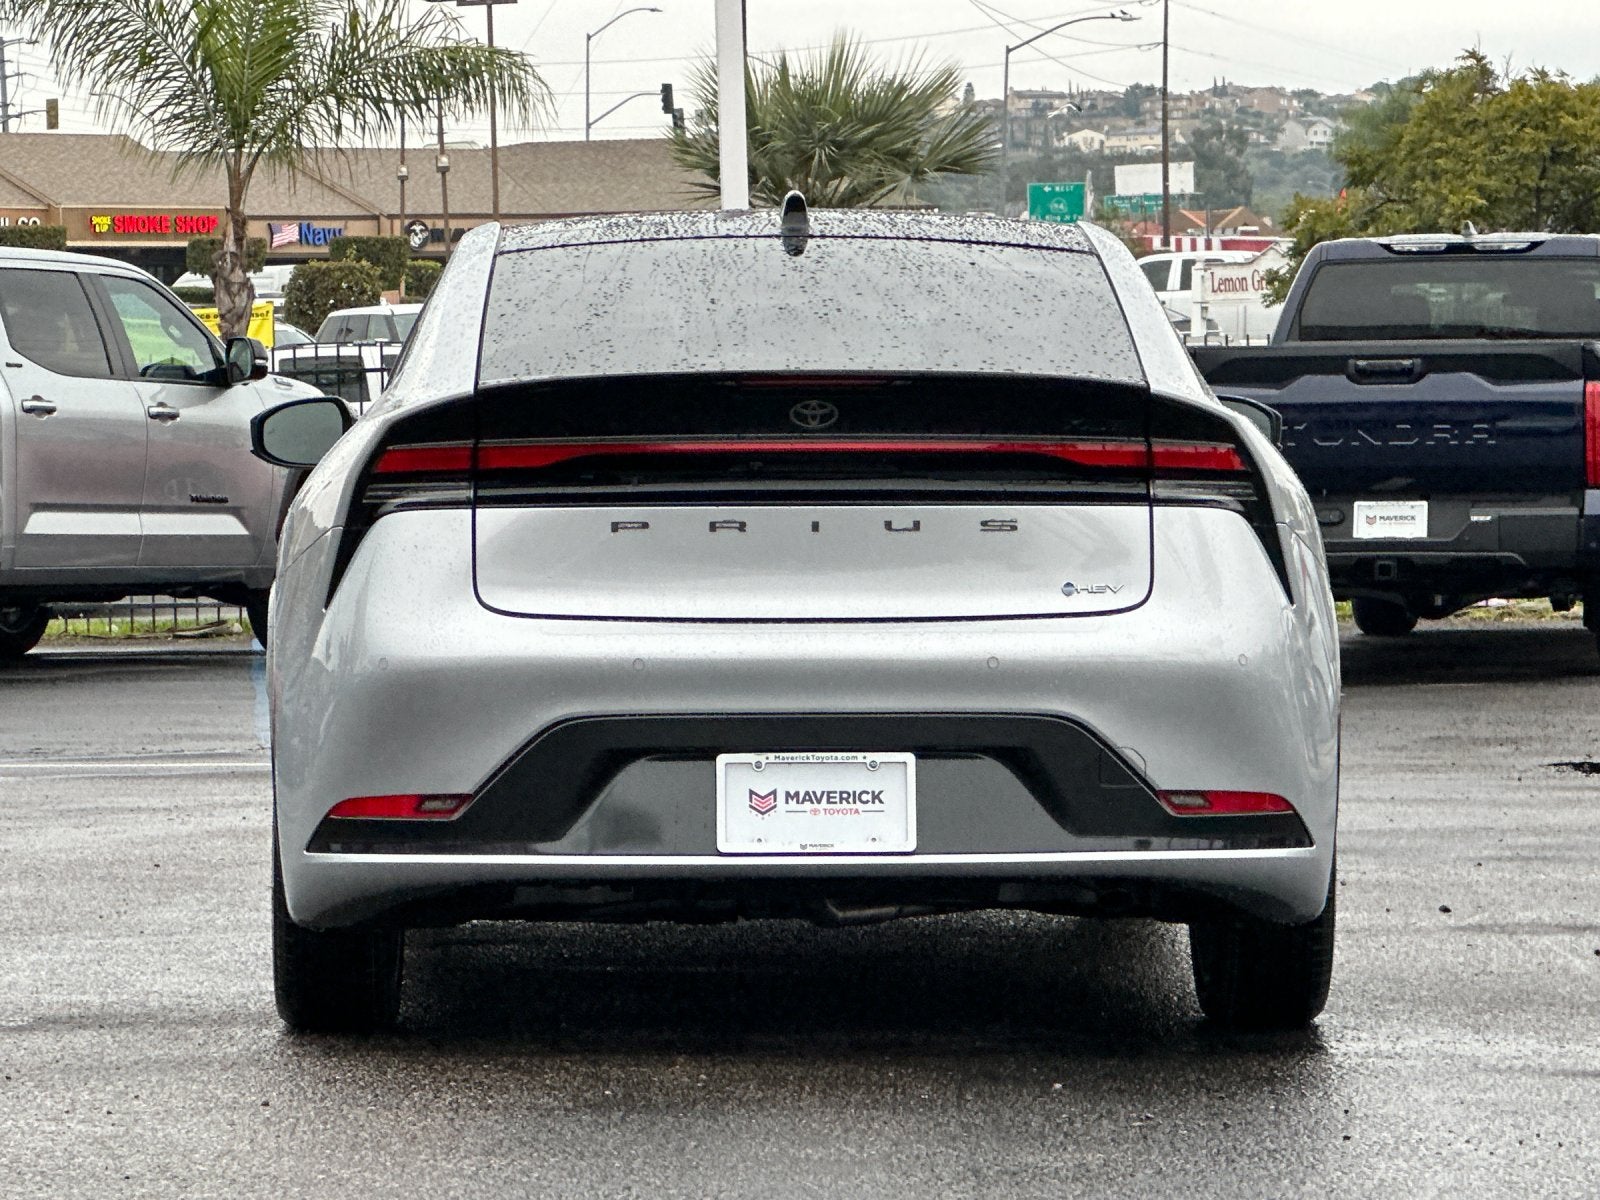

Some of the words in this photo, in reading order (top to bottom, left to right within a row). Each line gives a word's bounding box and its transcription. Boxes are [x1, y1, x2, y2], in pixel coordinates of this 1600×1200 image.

[92, 215, 111, 224] SMOKE
[113, 214, 171, 233] SMOKE
[174, 214, 219, 234] SHOP
[1210, 271, 1248, 293] Lemon
[1379, 514, 1416, 522] MAVERICK
[610, 518, 1018, 533] PRIUS
[1076, 584, 1125, 594] HEV
[774, 754, 858, 762] MaverickToyota.com
[784, 790, 885, 805] MAVERICK
[822, 808, 860, 816] TOYOTA
